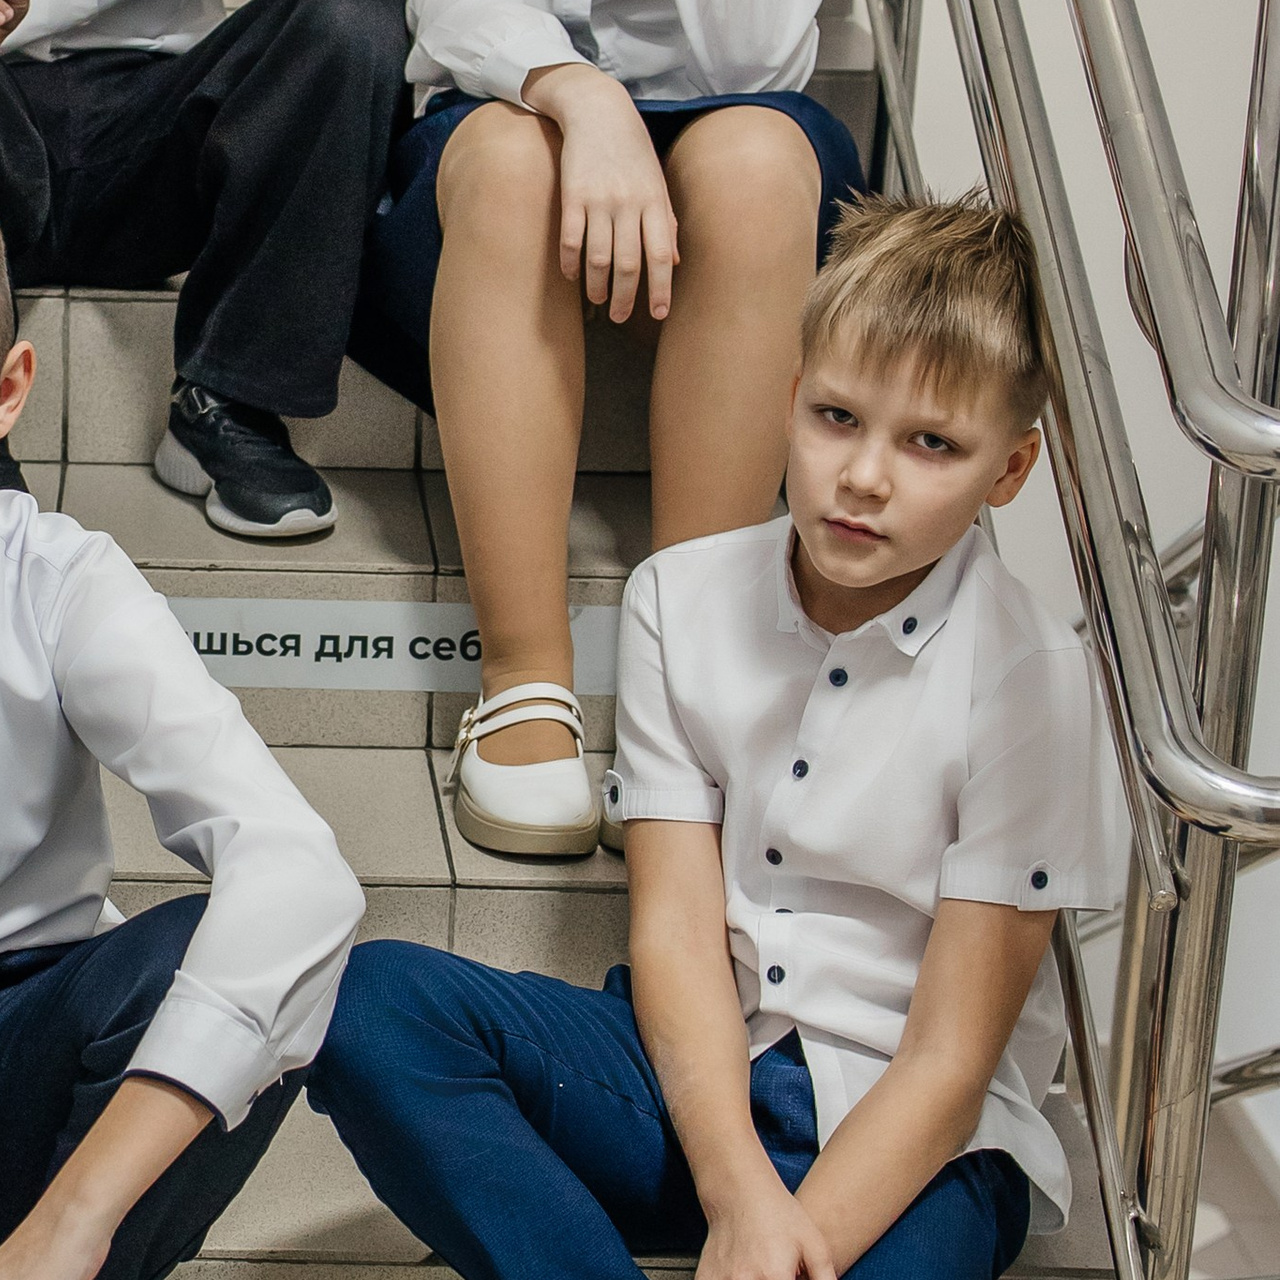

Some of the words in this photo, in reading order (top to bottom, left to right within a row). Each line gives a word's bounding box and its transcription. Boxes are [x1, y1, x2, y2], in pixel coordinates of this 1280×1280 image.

[185, 631, 301, 657] шься
[314, 634, 394, 663] для
[408, 629, 482, 662] себ
